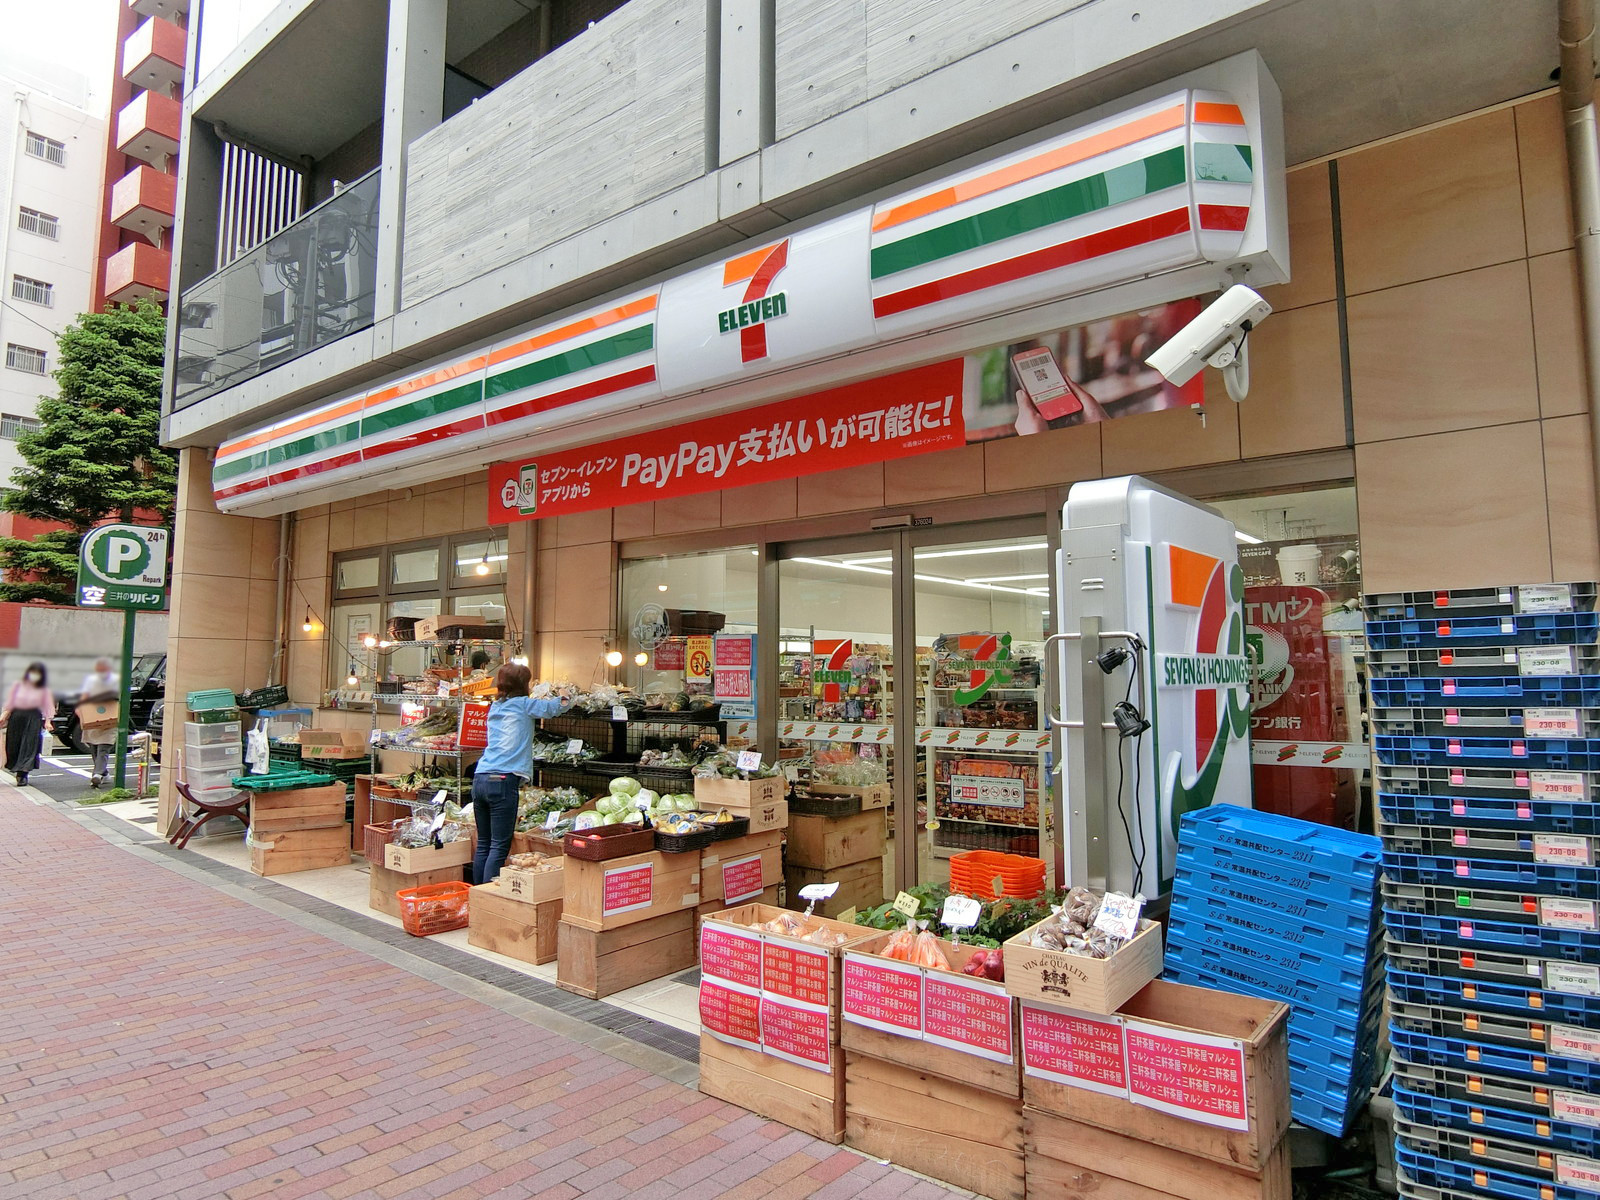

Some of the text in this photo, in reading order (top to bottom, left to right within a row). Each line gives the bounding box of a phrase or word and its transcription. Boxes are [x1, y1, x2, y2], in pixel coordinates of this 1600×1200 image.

[541, 482, 591, 504] アプリから
[147, 532, 165, 542] 24h
[108, 537, 141, 574] P
[143, 575, 161, 583] Repark
[81, 586, 106, 605] 空
[110, 592, 160, 604] 三井のリパーク
[1539, 721, 1566, 729] 230-08
[1545, 785, 1572, 793] 230-08
[1291, 851, 1313, 863] 2311
[1549, 847, 1576, 856] 230-08
[1289, 878, 1311, 890] 2312
[1286, 904, 1308, 917] 2311
[1554, 911, 1583, 919] 230-08
[704, 932, 759, 952] 三軒茶屋マルシェ三軒茶屋マルシェ
[1283, 930, 1305, 943] 2312
[703, 943, 759, 963] マルシェ三軒茶屋マルシェ三軒茶屋
[703, 952, 759, 974] 三軒茶屋マルシェ三軒茶屋マルシェ
[1280, 957, 1301, 970] 2312
[703, 963, 759, 985] マルシェ三軒茶屋マルシェ三軒茶屋
[1022, 960, 1038, 971] VIN
[1039, 958, 1048, 967] de
[847, 964, 918, 988] 三軒茶屋マルシェ三軒茶屋マルシェ
[847, 977, 918, 1001] マルシェ三軒茶屋マルシェ三軒茶屋
[927, 983, 1006, 1010] 三軒茶屋マルシェ三軒茶屋マルシェ
[1276, 984, 1299, 997] 2311
[846, 988, 918, 1013] 三軒茶屋マルシェ三軒茶屋マルシェ
[927, 996, 1006, 1024] マルシェ三軒茶屋マルシェ三軒茶屋
[763, 1003, 824, 1025] 三軒茶屋マルシェ三軒茶屋マルシェ
[846, 1000, 918, 1026] マルシェ三軒茶屋マルシェ三軒茶屋
[927, 1008, 1007, 1037] 三軒茶屋マルシェ三軒茶屋マルシェ
[763, 1014, 825, 1038] マルシェ三軒茶屋マルシェ三軒茶屋
[763, 1024, 826, 1049] 三軒茶屋マルシェ三軒茶屋マルシェ
[927, 1021, 1007, 1050] マルシェ三軒茶屋マルシェ三軒茶屋
[1026, 1012, 1117, 1040] 三軒茶屋マルシェ三軒茶屋マルシェ
[764, 1035, 826, 1061] マルシェ三軒茶屋マルシェ三軒茶屋
[1027, 1026, 1119, 1055] マルシェ三軒茶屋マルシェ三軒茶屋
[1130, 1035, 1236, 1066] 三軒茶屋マルシェ三軒茶屋マルシェ
[1564, 1040, 1592, 1051] 230-08
[1027, 1039, 1120, 1068] 三軒茶屋マルシェ三軒茶屋マルシェ
[1027, 1054, 1122, 1083] マルシェ三軒茶屋マルシェ三軒茶屋
[1131, 1051, 1237, 1082] マルシェ三軒茶屋マルシェ三軒茶屋
[1132, 1064, 1239, 1097] 三軒茶屋マルシェ三軒茶屋マルシェ
[1133, 1080, 1240, 1114] マルシェ三軒茶屋マルシェ三軒茶屋
[1567, 1106, 1594, 1116] 230-08
[1571, 1170, 1599, 1182] 230-08
